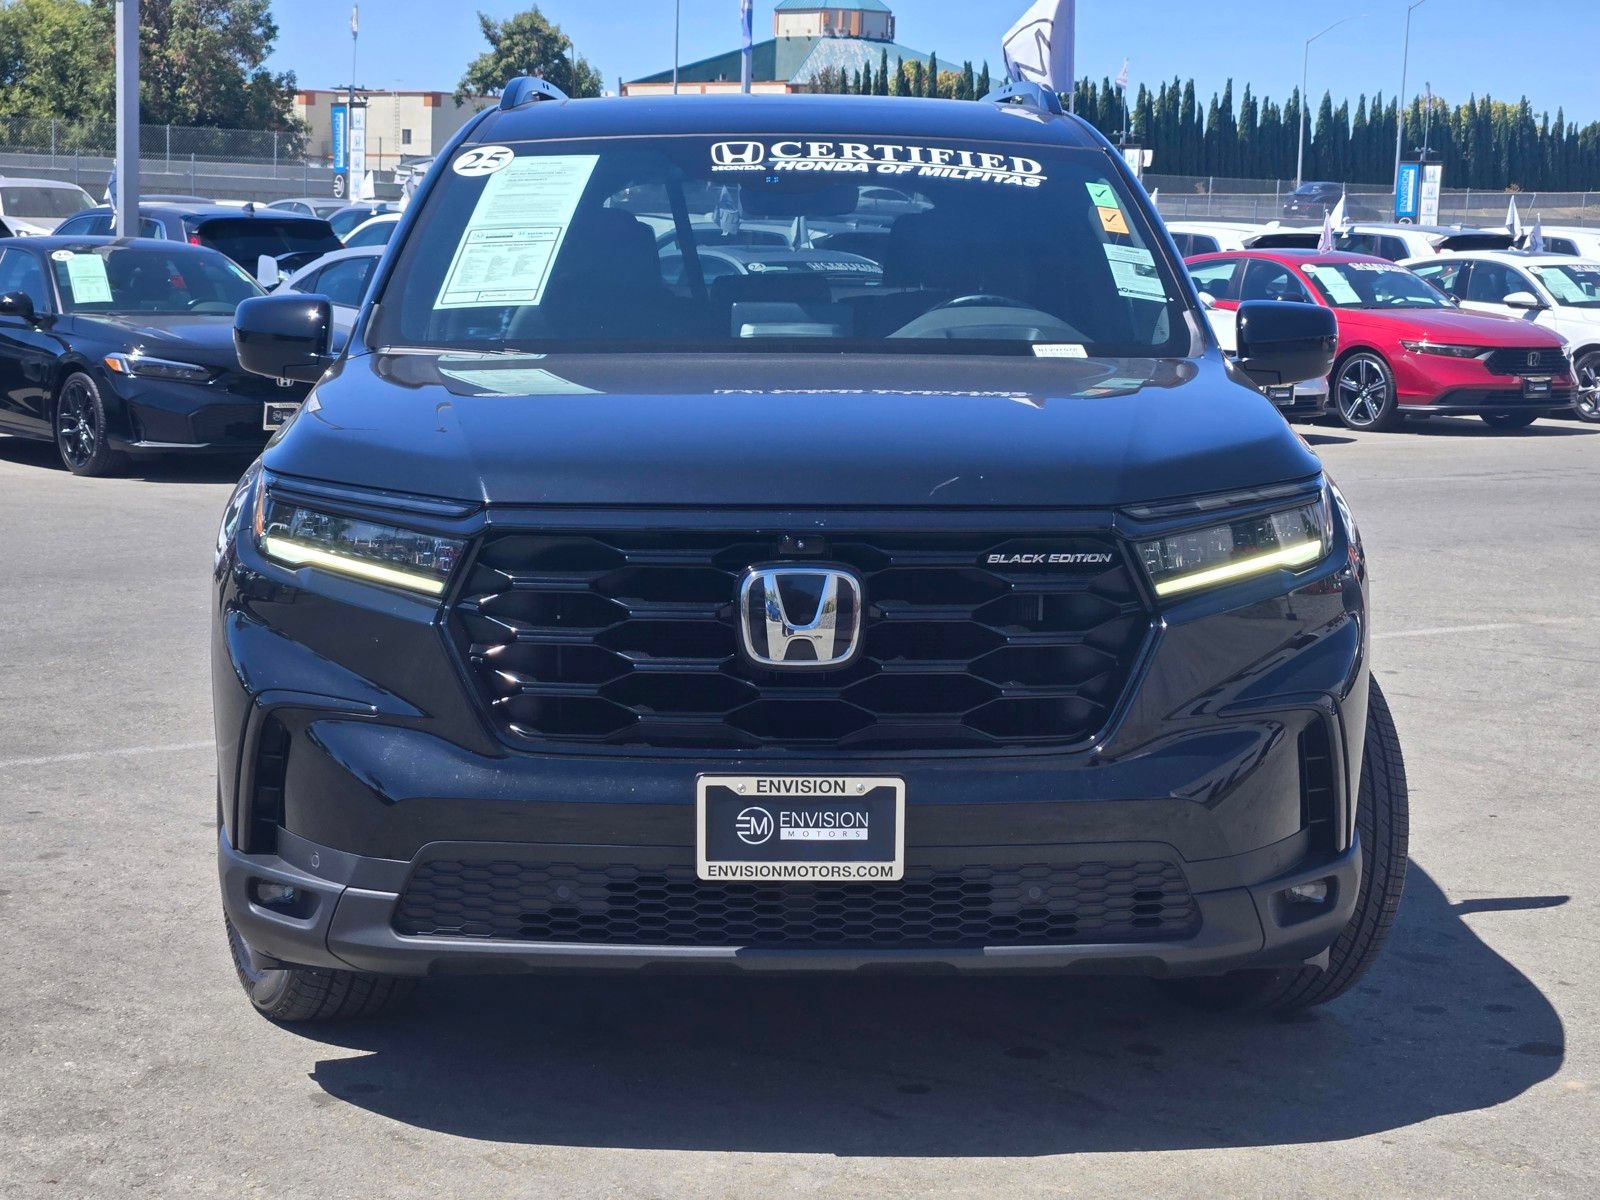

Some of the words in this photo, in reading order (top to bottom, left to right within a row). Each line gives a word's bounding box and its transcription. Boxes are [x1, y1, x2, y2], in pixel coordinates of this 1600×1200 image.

[457, 151, 510, 170] 25
[770, 141, 1042, 175] CERTIFIED
[774, 161, 869, 173] HONDA
[876, 164, 914, 174] OF
[918, 166, 1041, 188] MILPITAS
[1399, 169, 1410, 212] ENVISION
[987, 554, 1046, 563] BLACK
[1048, 554, 1112, 563] EDITION
[756, 780, 846, 793] ENVISION
[780, 811, 868, 828] ENVISION
[708, 865, 893, 877] ENVISIONMOTORS.COM
